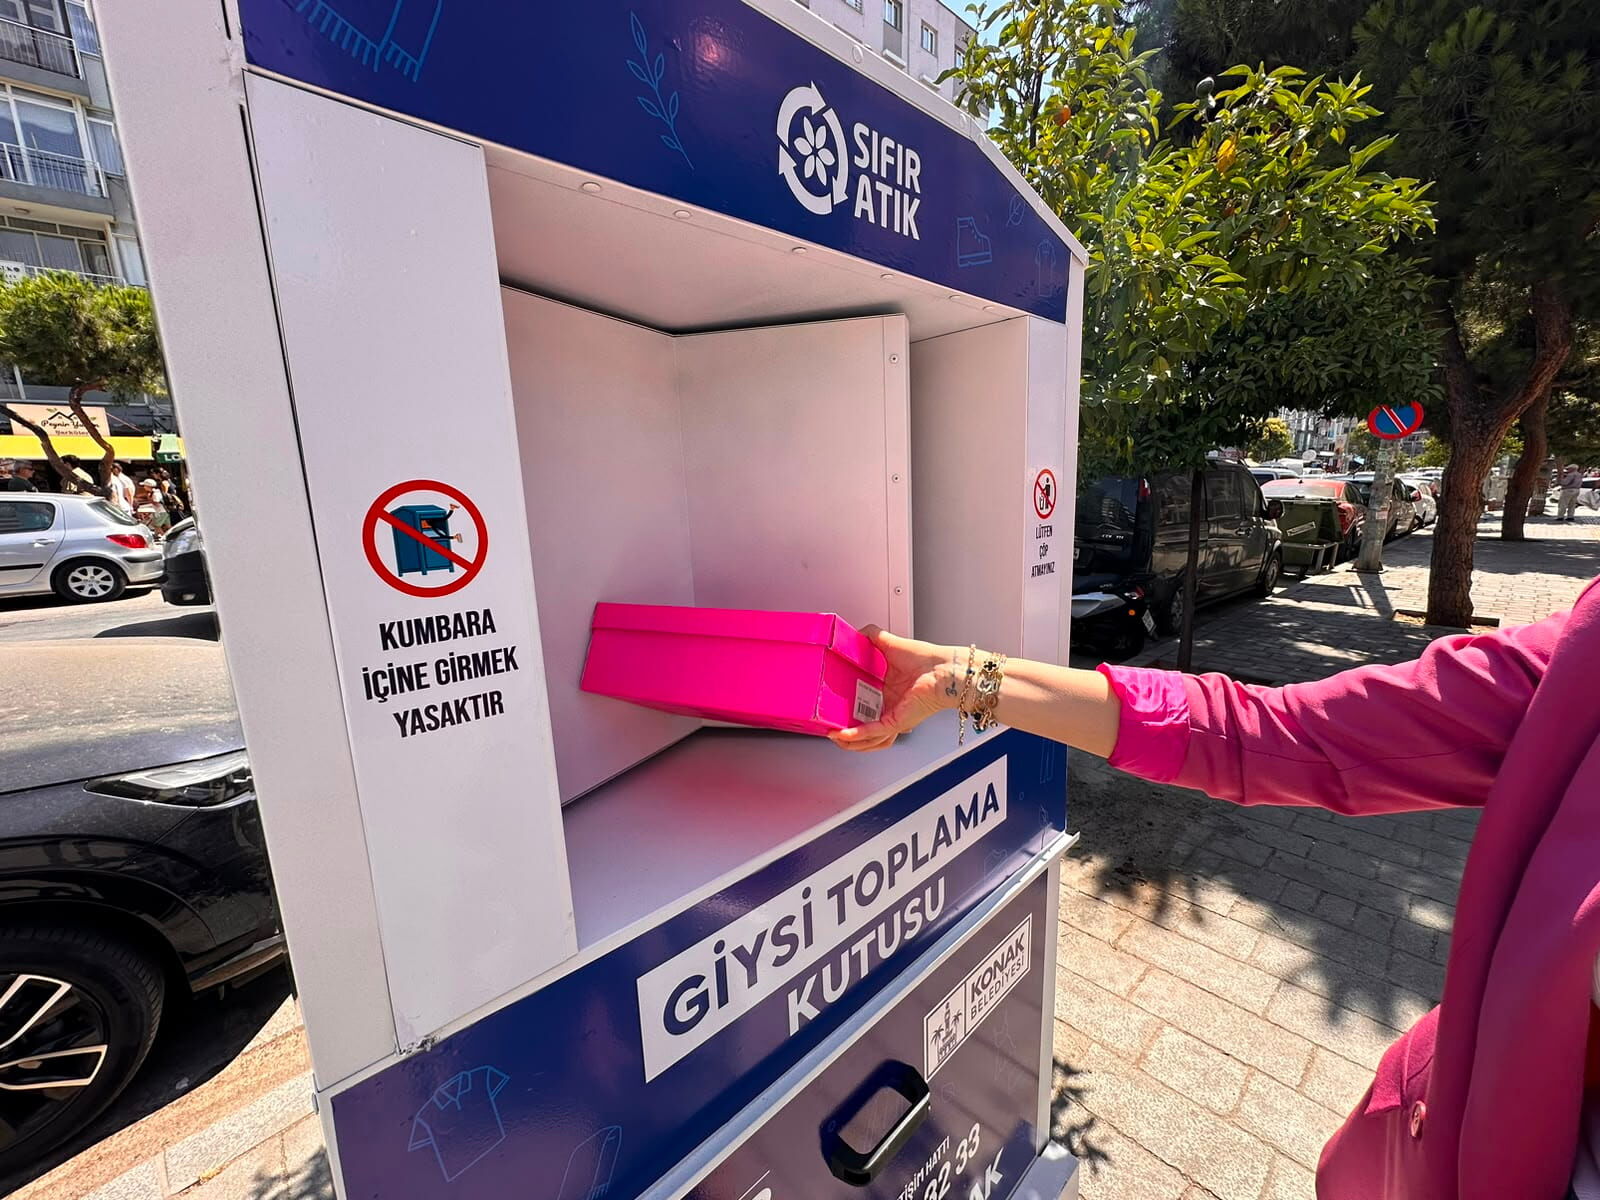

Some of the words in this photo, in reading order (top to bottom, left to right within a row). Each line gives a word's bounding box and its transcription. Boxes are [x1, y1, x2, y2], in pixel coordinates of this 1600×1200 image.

[853, 122, 921, 194] SIFIR
[854, 174, 921, 240] ATIK
[1035, 524, 1053, 539] LÜTFEN
[1039, 542, 1049, 559] ÇÖP
[1031, 561, 1055, 578] ATMAYINIZ
[379, 608, 496, 651] KUMBARA
[362, 662, 430, 702] İÇİNE
[435, 646, 519, 686] GİRMEK
[393, 690, 504, 738] YASAKTIR
[663, 886, 814, 1036] GİYSİ
[827, 782, 1000, 926] TOPLAMA
[786, 876, 946, 1036] KUTUSU
[971, 932, 1025, 1003] KONAK
[970, 954, 1024, 1021] BELEDİYESİ
[925, 1136, 950, 1176] HATTI
[955, 1122, 981, 1175] 33
